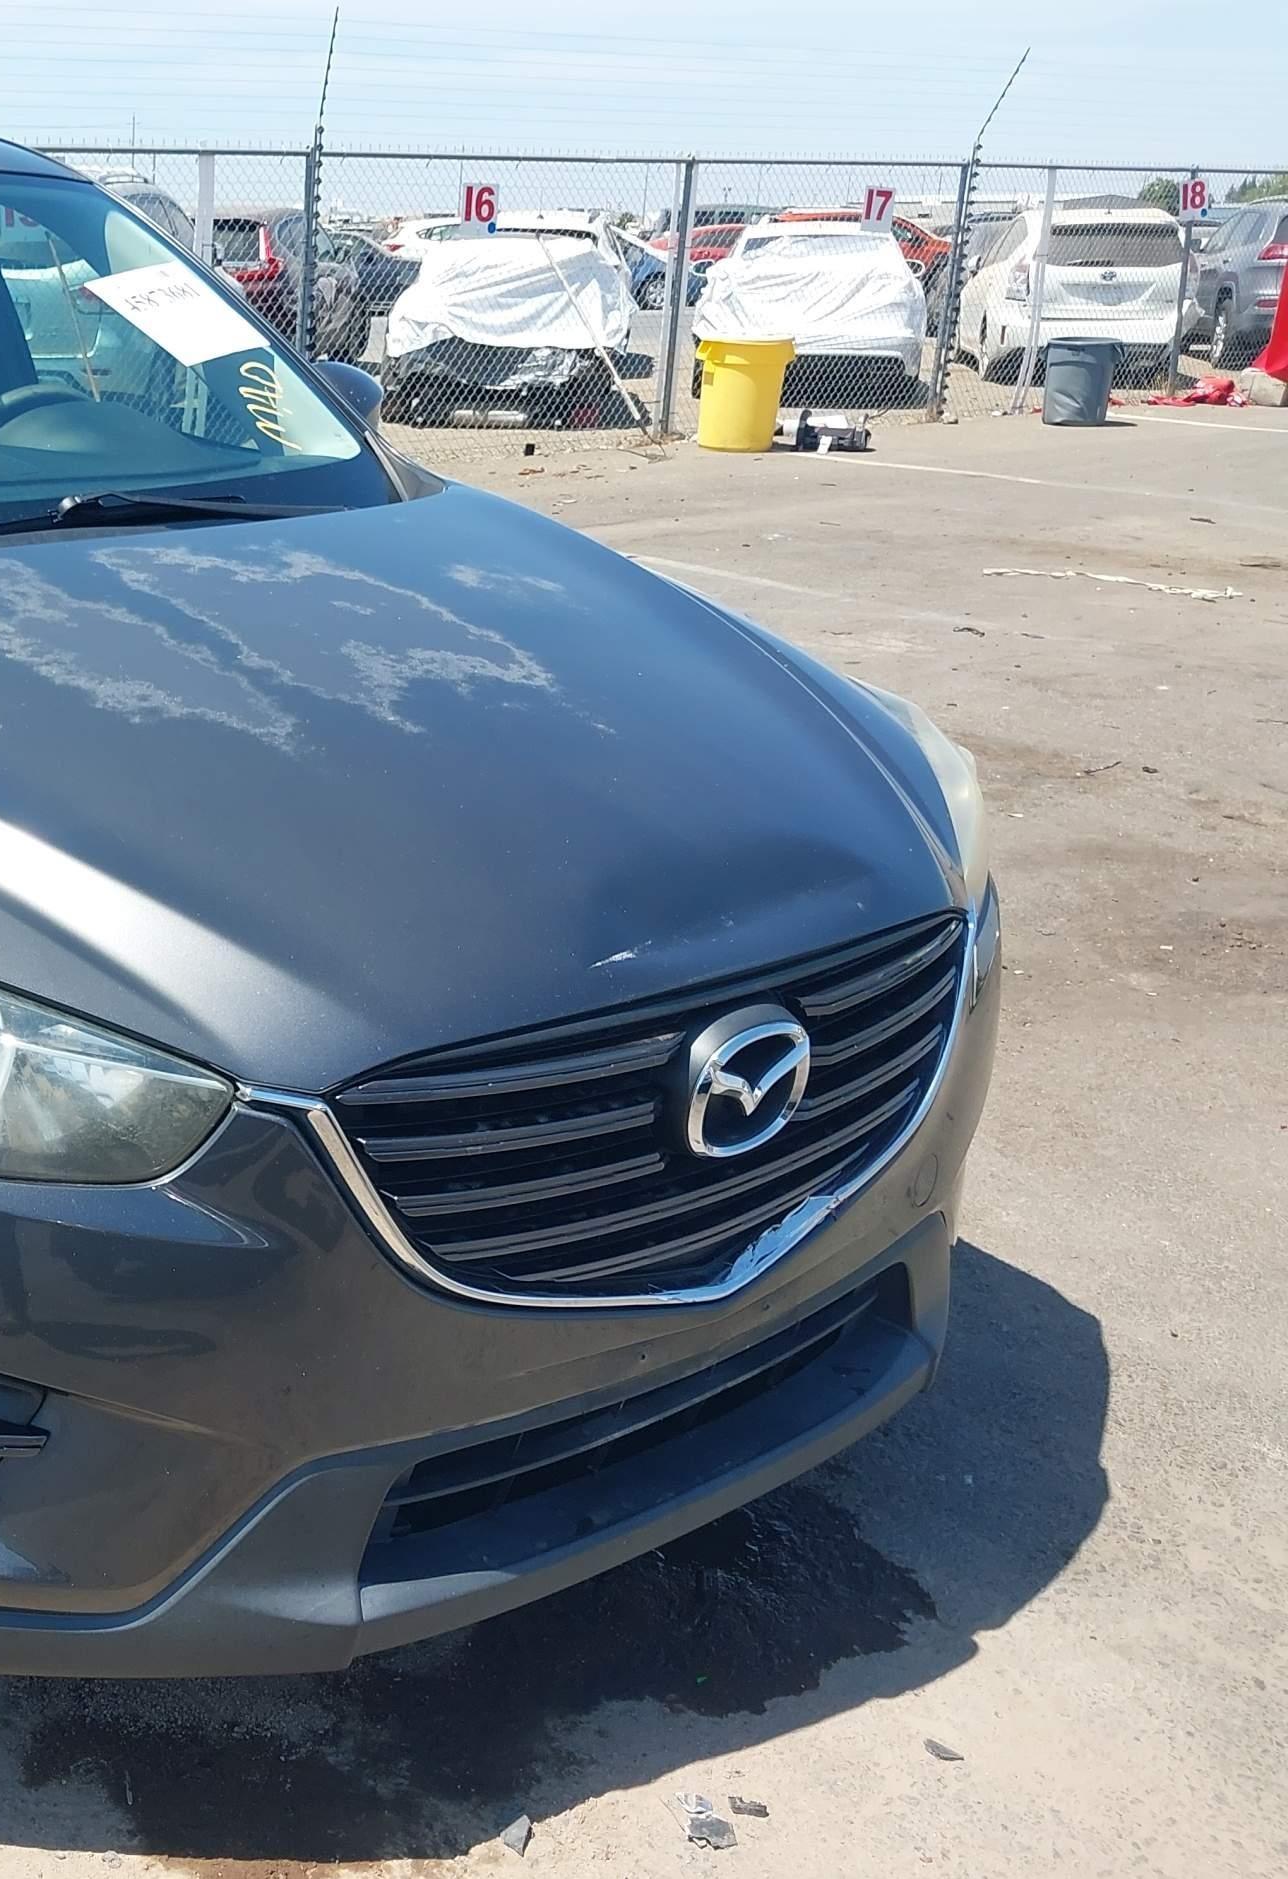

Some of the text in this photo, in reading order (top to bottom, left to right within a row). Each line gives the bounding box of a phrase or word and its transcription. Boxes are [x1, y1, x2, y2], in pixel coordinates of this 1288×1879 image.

[464, 186, 495, 223] 16
[864, 188, 893, 221] 17
[1182, 181, 1206, 210] 18
